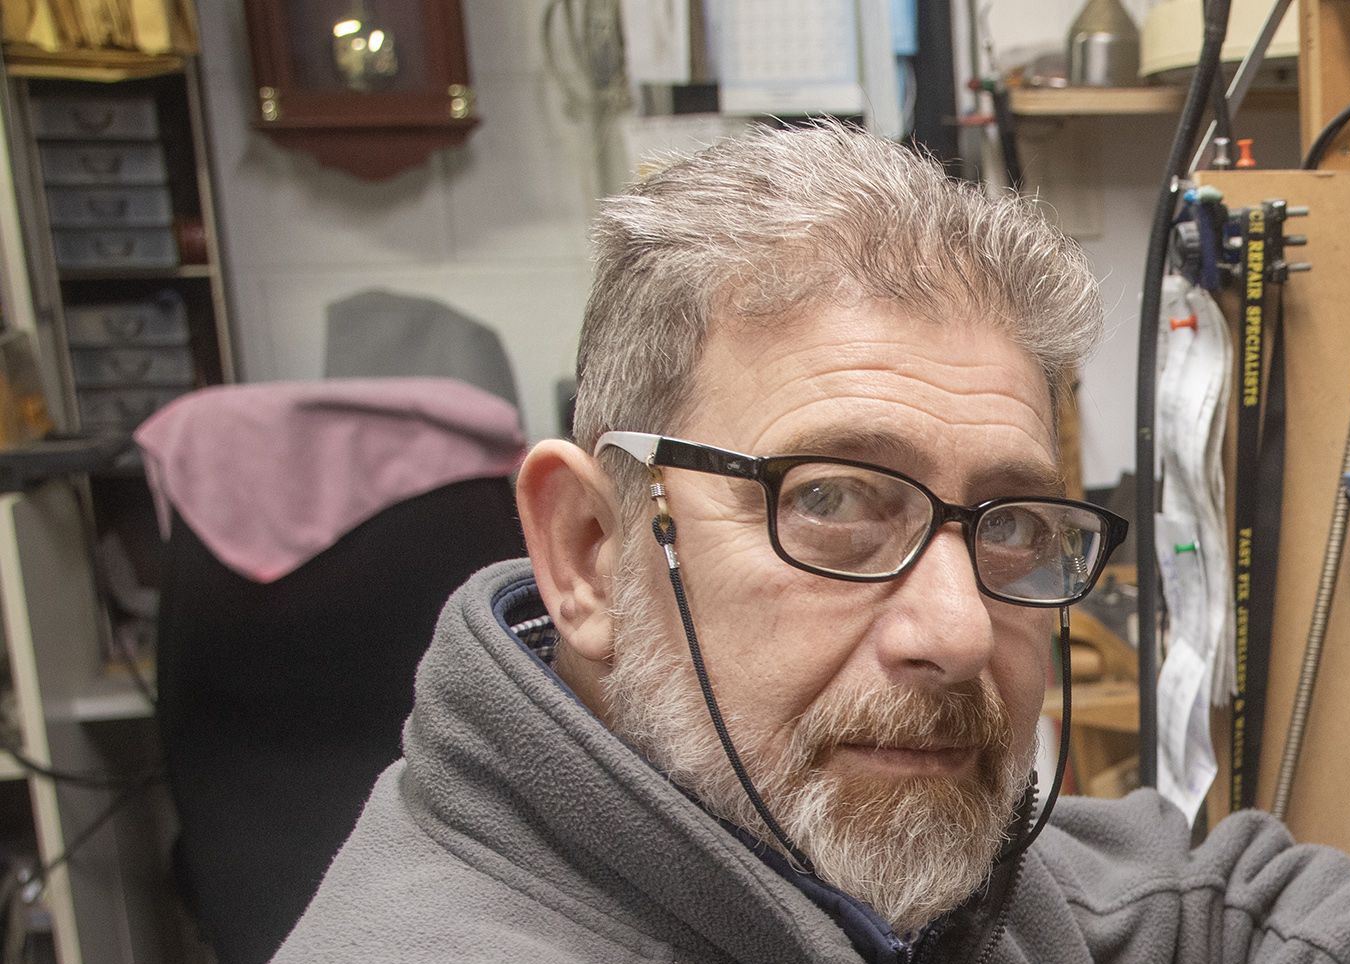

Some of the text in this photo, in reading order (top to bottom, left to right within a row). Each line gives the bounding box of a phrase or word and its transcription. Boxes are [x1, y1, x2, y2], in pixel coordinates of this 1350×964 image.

[1247, 240, 1264, 299] REPAIR
[1243, 305, 1262, 407] SPECIALISTS
[1239, 527, 1252, 566] FAST
